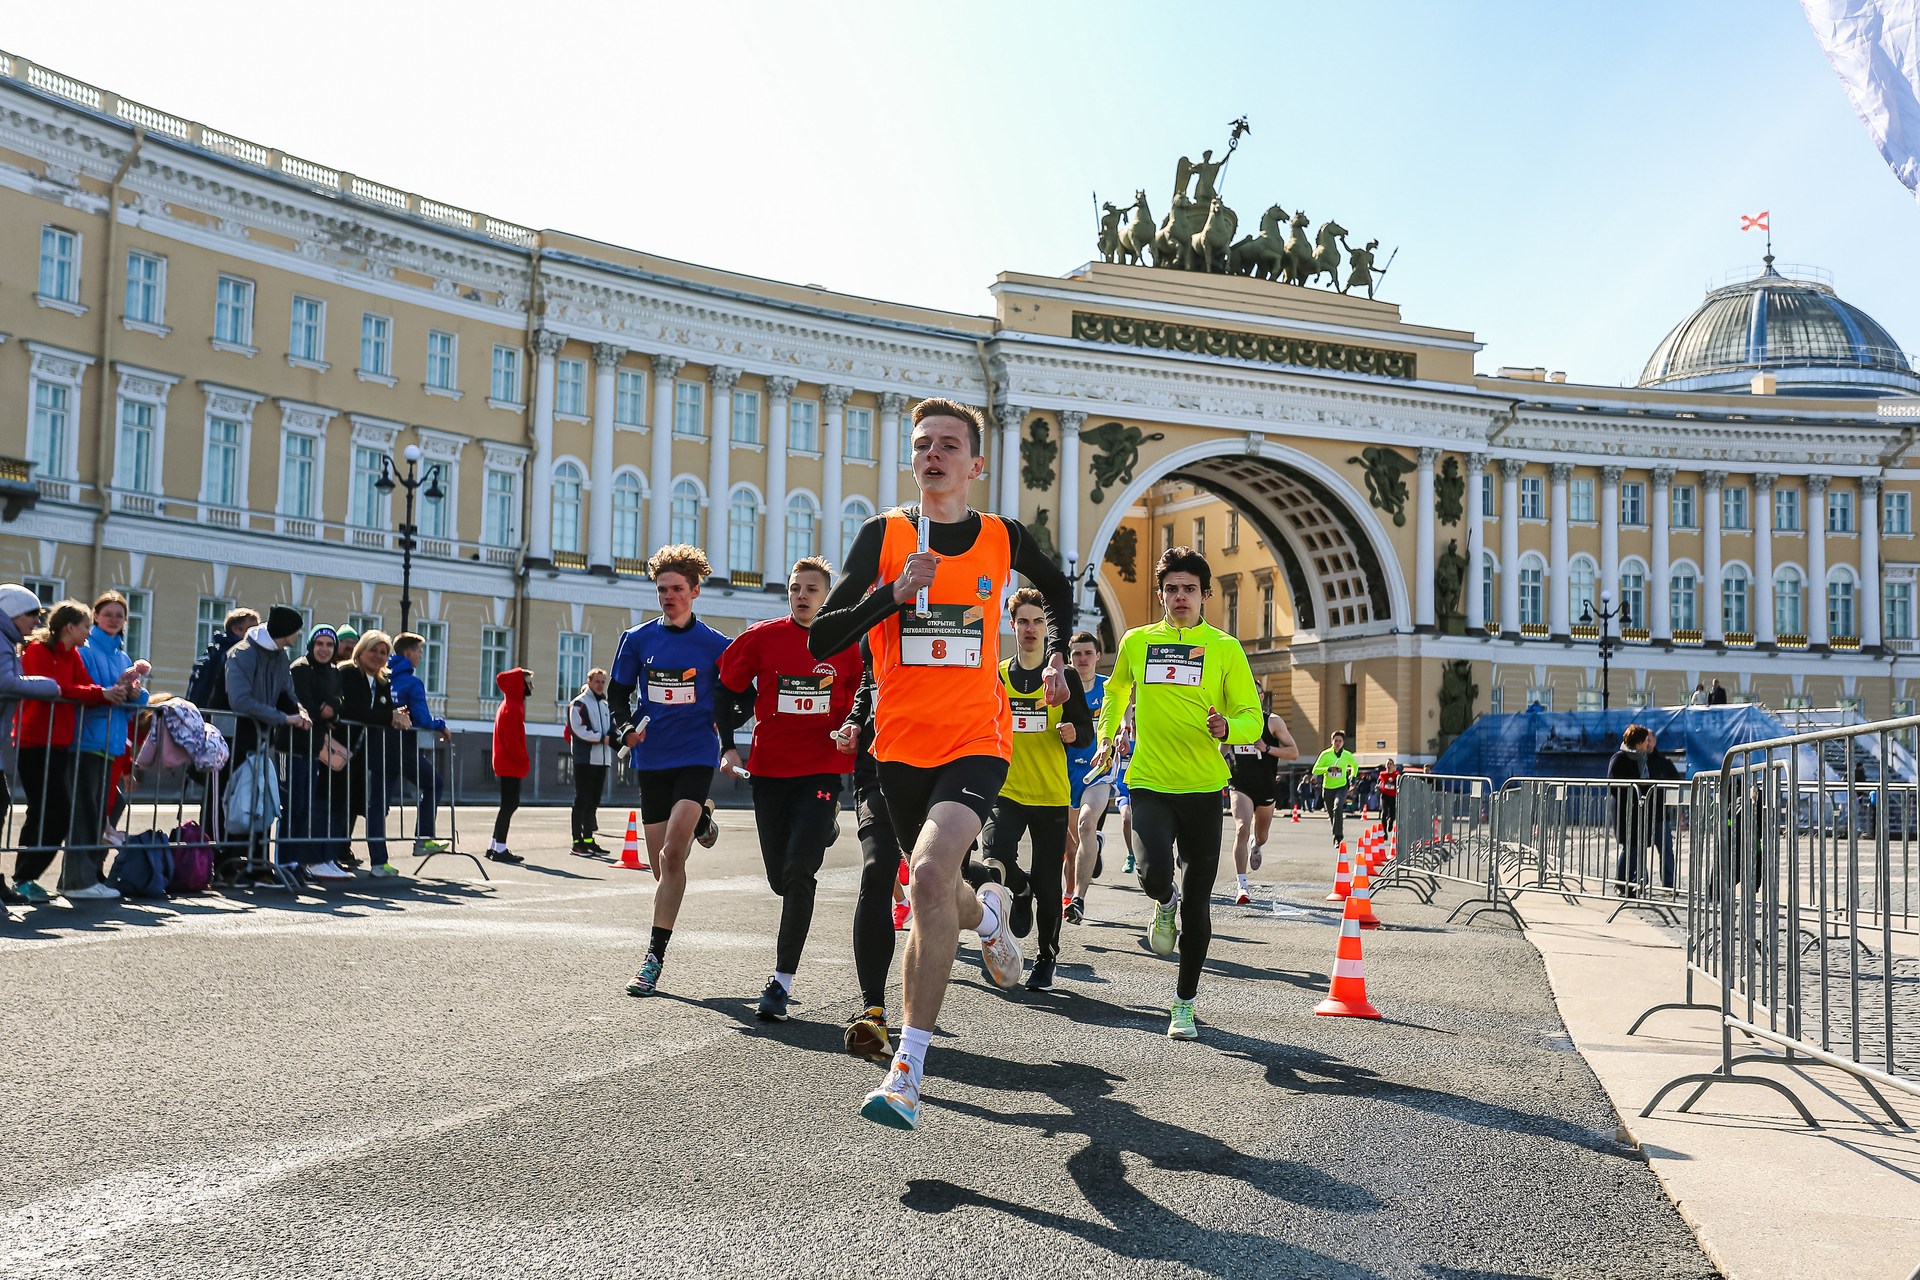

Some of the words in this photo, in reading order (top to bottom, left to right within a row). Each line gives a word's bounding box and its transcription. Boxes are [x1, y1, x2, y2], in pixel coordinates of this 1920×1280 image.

[931, 639, 947, 659] 8
[970, 652, 975, 661] 1
[1166, 666, 1176, 680] 2
[664, 689, 673, 701] 3
[794, 698, 814, 711] 10
[1018, 718, 1027, 729] 5
